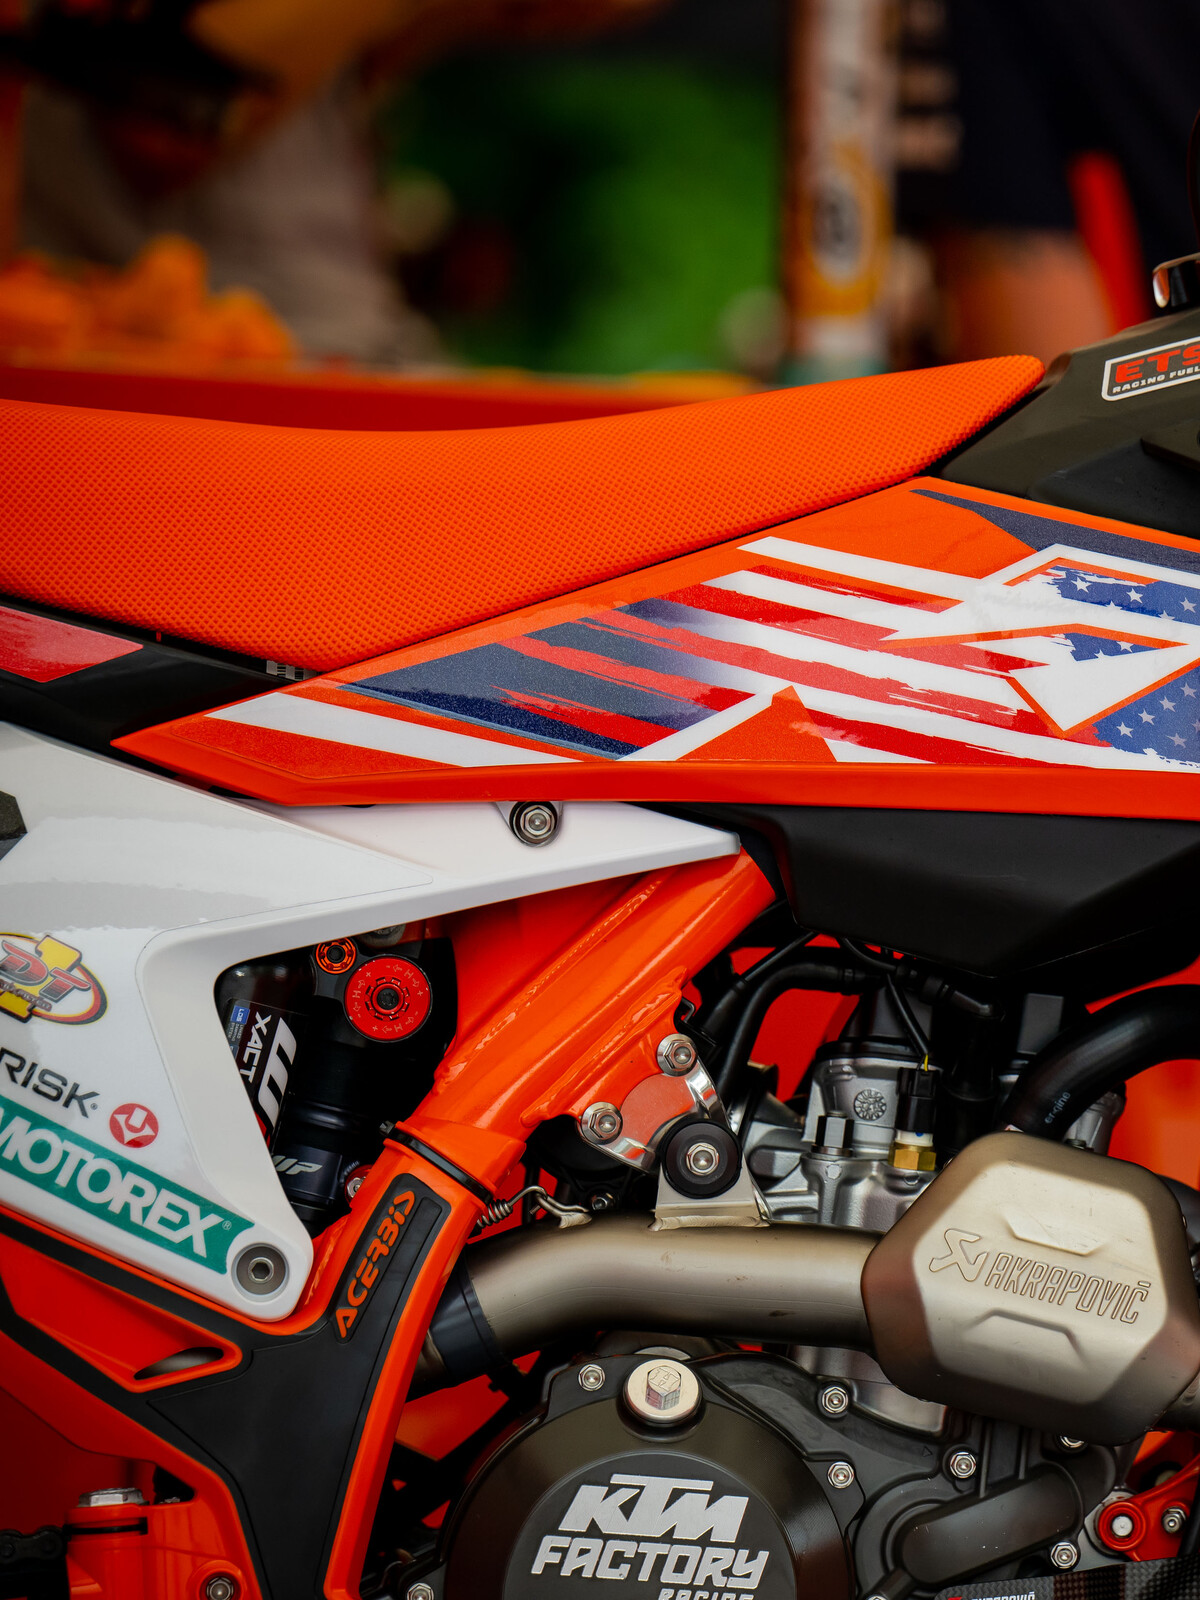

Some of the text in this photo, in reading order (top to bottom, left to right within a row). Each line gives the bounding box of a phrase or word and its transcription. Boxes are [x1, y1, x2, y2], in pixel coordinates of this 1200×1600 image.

[1112, 374, 1165, 393] RACING
[0, 1046, 100, 1118] RISK
[239, 1012, 271, 1083] XACT
[335, 1190, 415, 1338] ACERBIS
[984, 1252, 1151, 1324] AKRAPOVIČ
[558, 1474, 749, 1543] KTM
[531, 1535, 769, 1589] FACTORY
